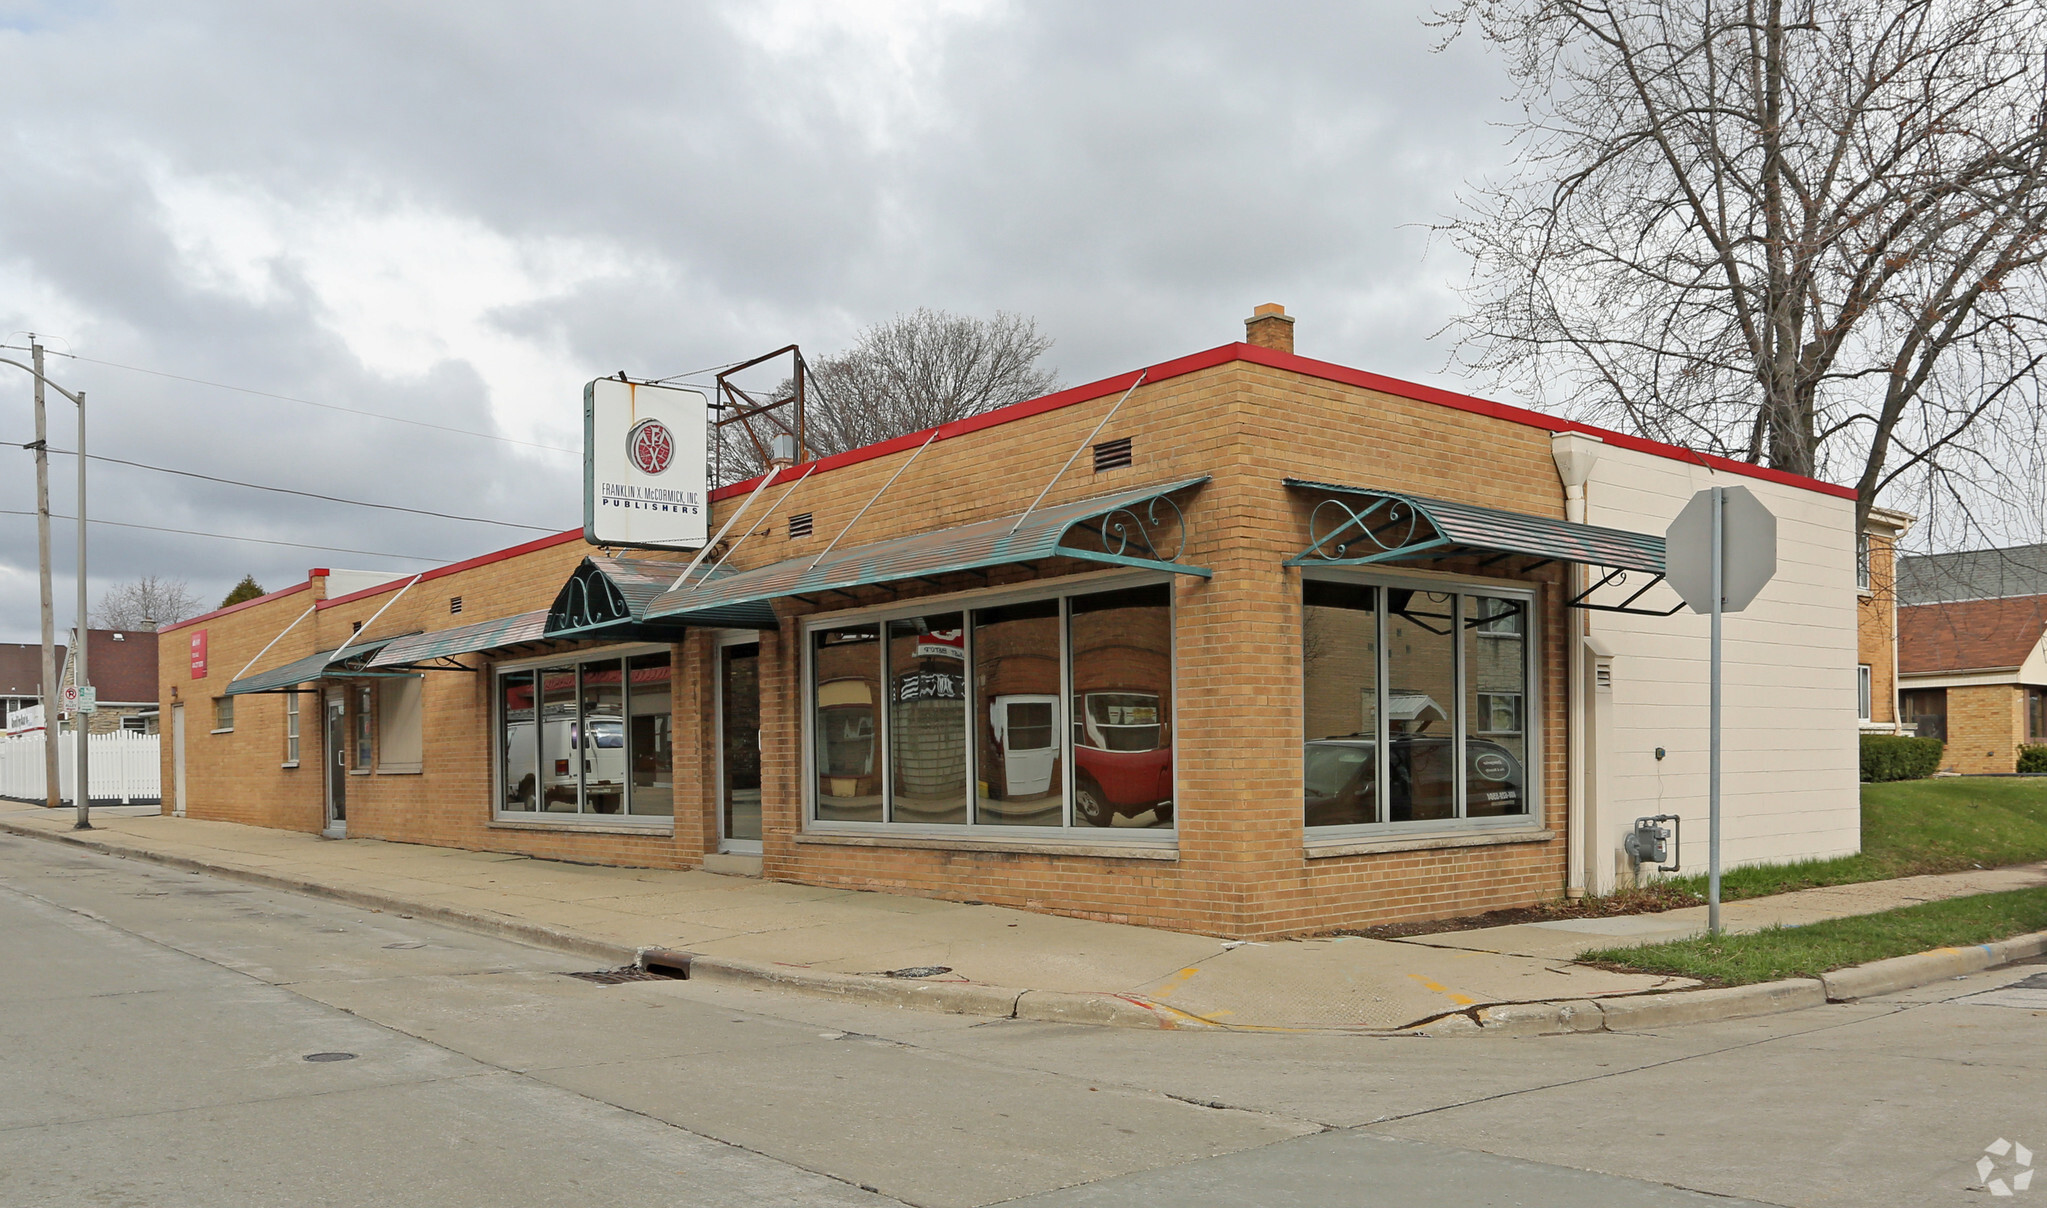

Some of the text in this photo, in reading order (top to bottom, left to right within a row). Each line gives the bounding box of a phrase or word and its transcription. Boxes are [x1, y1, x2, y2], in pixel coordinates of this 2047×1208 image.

[602, 483, 700, 505] FRANKLIN X. McCORMICK, INC.
[602, 498, 698, 515] PUBLISHERS
